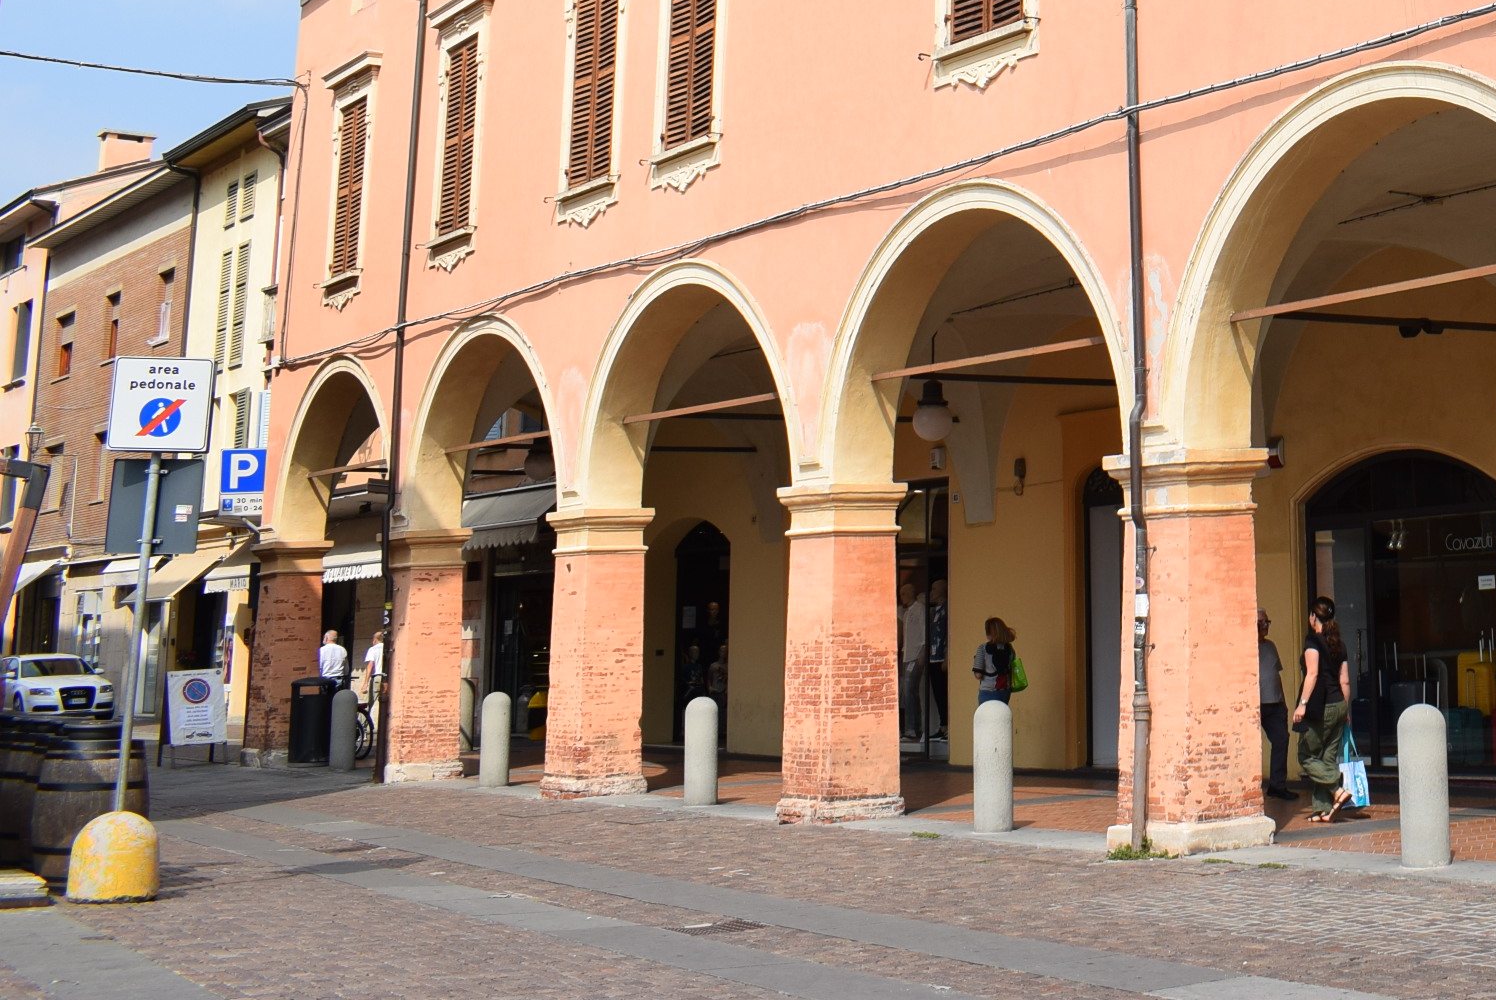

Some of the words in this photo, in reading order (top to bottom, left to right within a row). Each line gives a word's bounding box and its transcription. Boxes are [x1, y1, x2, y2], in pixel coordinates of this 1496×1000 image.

[148, 366, 180, 375] area
[129, 379, 196, 391] pedonale
[229, 452, 259, 490] P
